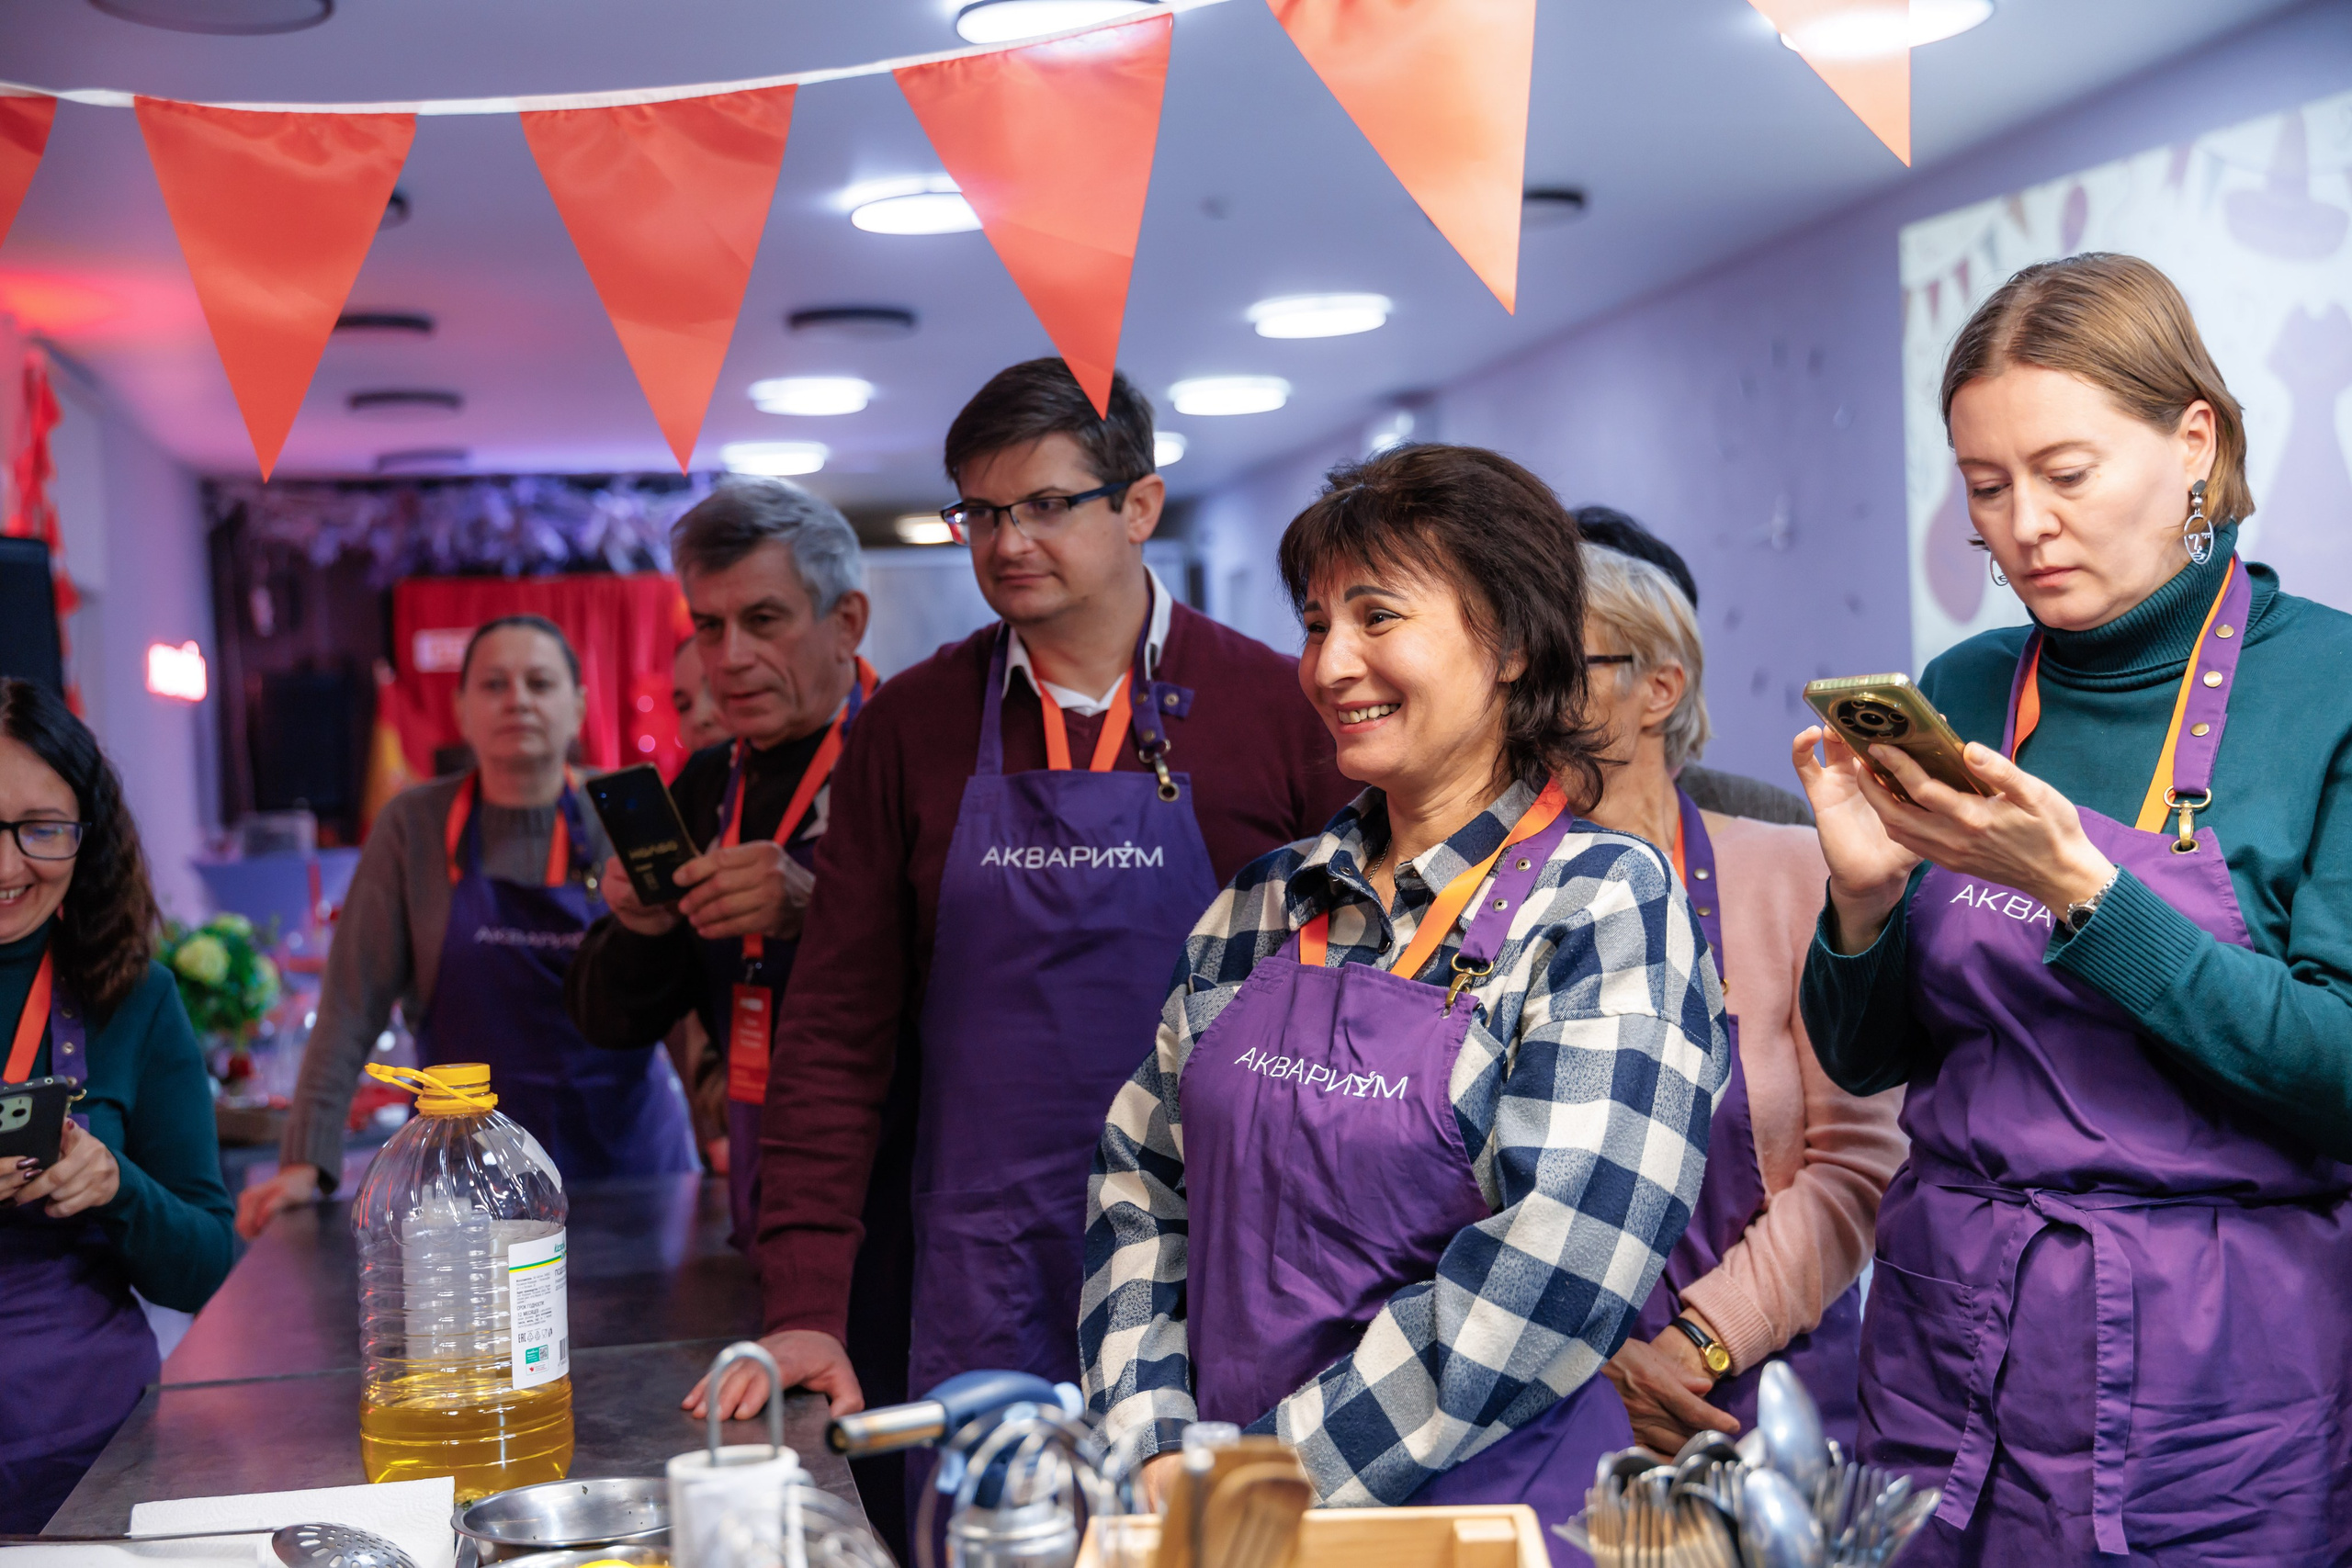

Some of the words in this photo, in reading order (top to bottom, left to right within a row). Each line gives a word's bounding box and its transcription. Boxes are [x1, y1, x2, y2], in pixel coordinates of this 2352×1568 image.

[980, 840, 1164, 869] АКВАРИУМ
[1949, 884, 2051, 928] АКВА
[1234, 1047, 1408, 1100] АКВАРИУМ
